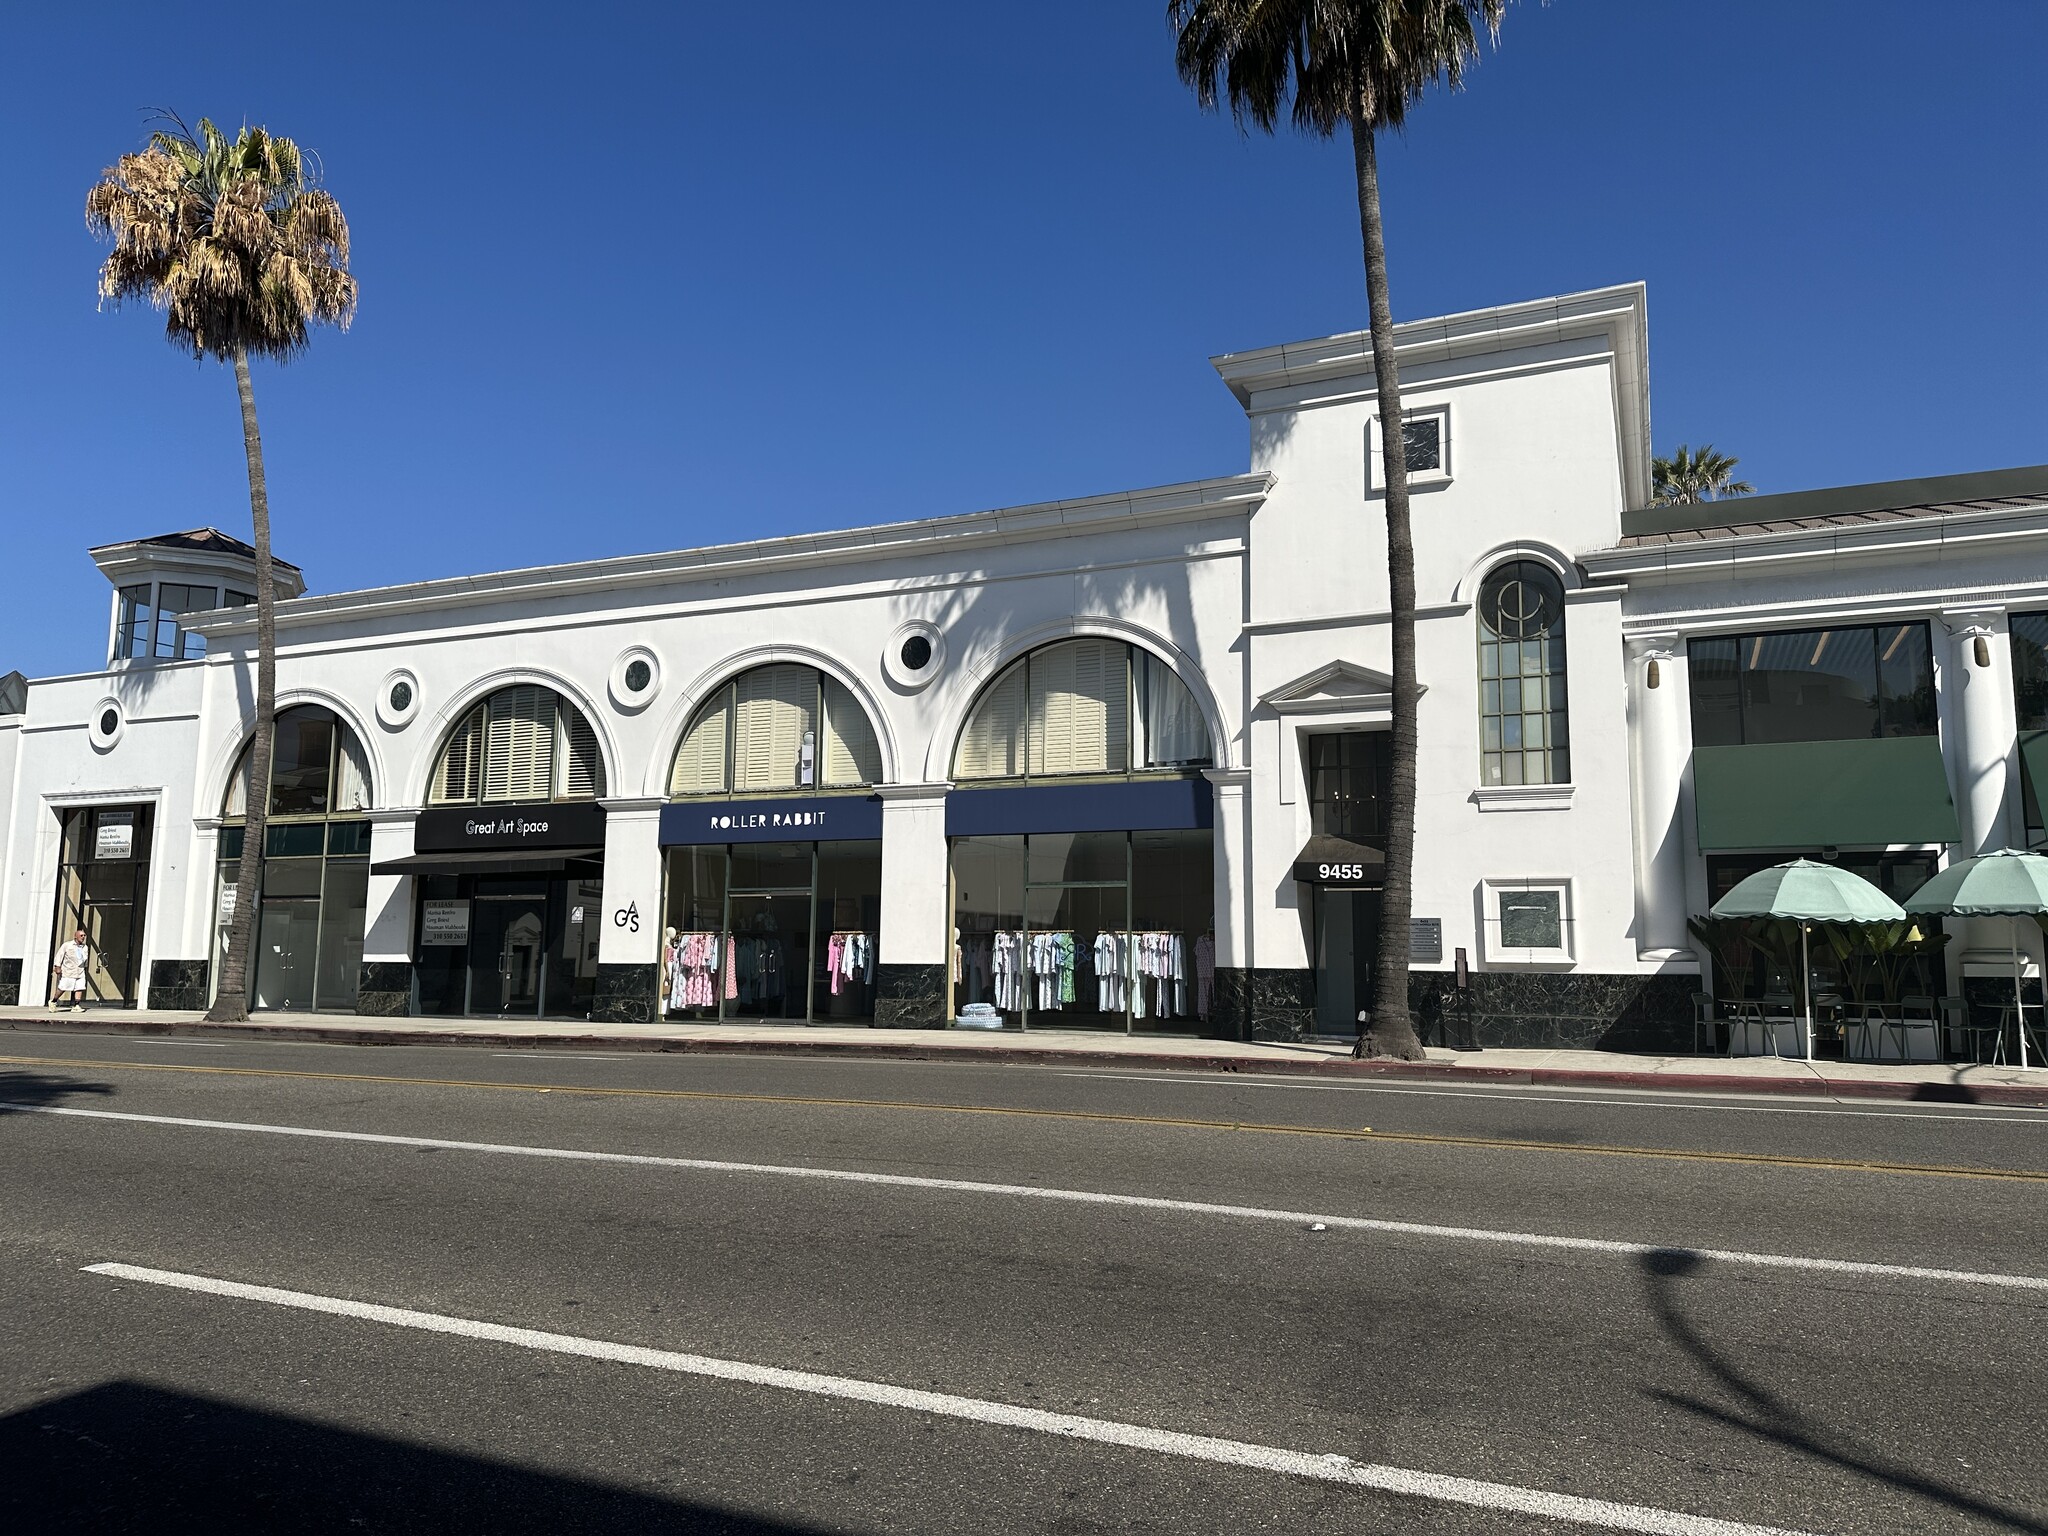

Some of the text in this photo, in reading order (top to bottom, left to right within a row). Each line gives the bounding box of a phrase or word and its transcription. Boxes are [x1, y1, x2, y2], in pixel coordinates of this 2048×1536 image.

[465, 817, 549, 837] Great Art Space
[710, 811, 826, 829] ROLLER RABBIT
[1318, 863, 1363, 880] 9455
